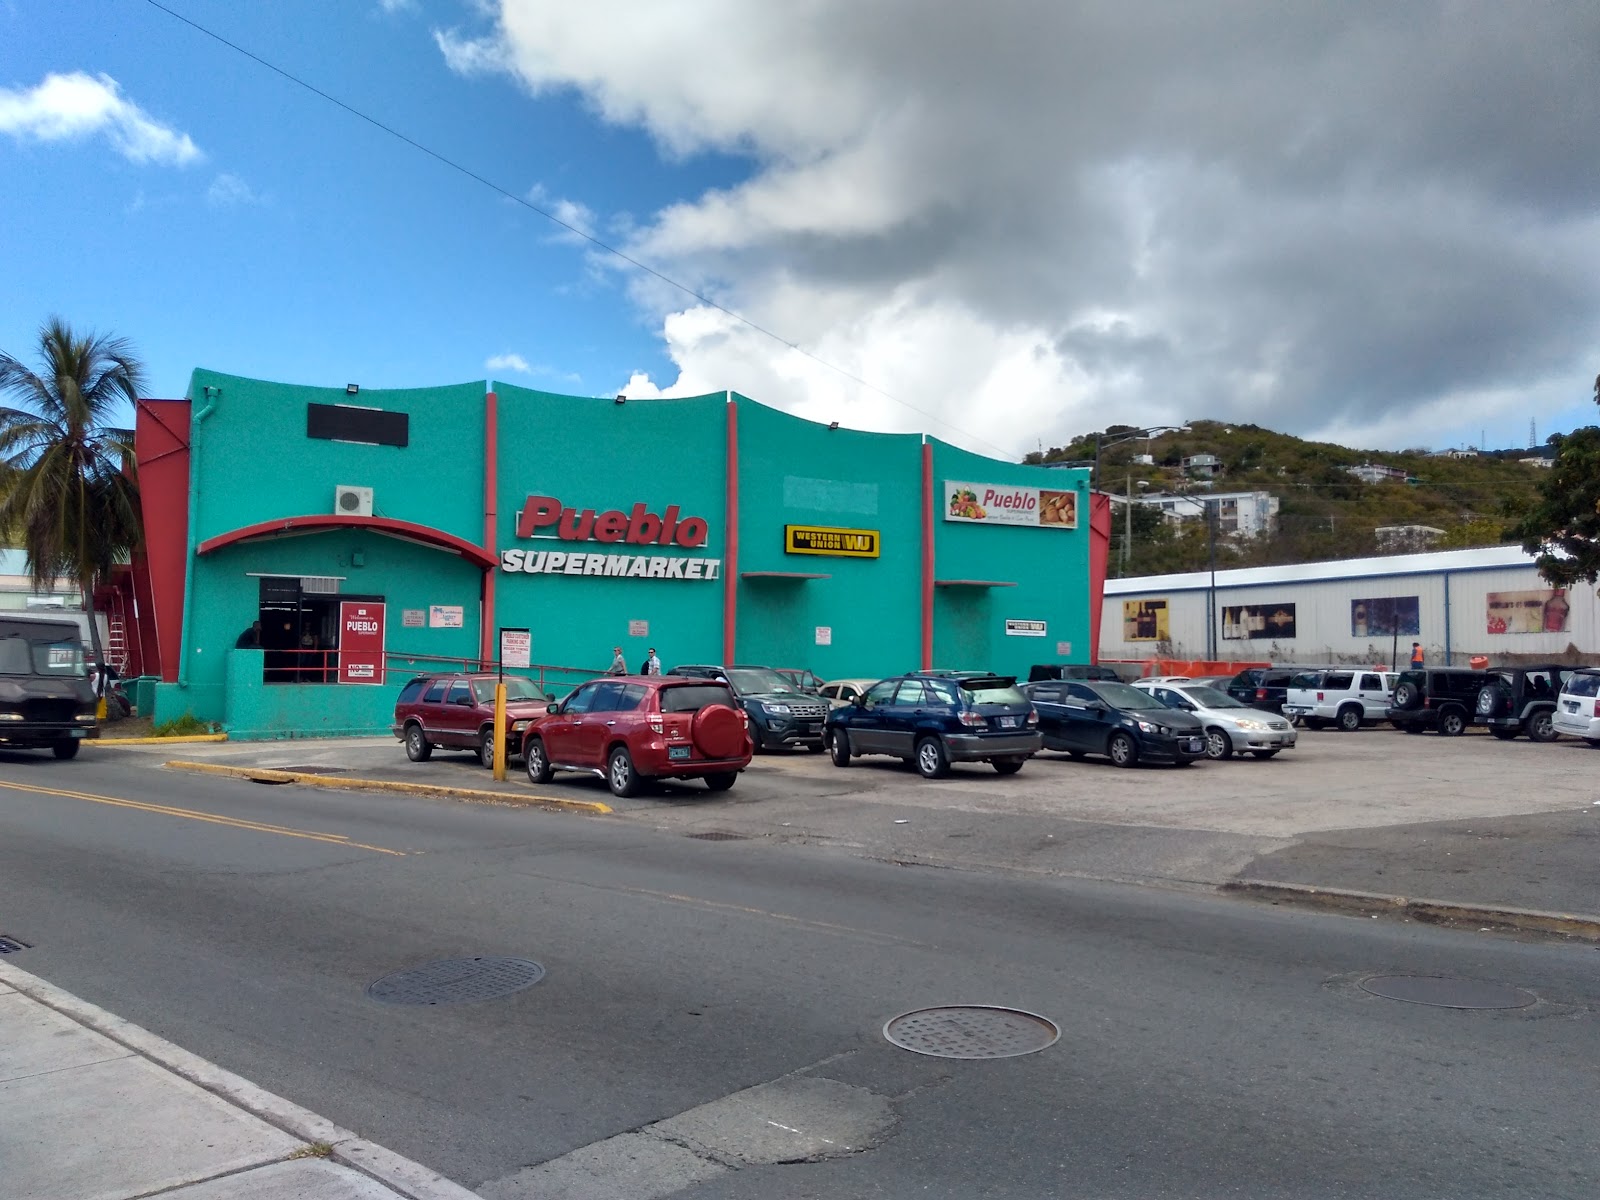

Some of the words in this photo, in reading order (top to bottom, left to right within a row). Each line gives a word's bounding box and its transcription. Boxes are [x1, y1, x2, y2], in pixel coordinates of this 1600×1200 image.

[982, 489, 1036, 510] Pueblo
[516, 495, 708, 548] Pueblo
[796, 531, 841, 542] WESTERN
[810, 540, 841, 549] UNION
[844, 535, 870, 551] WU
[502, 549, 720, 579] SUPERMARKET
[346, 620, 378, 632] PUEBLO
